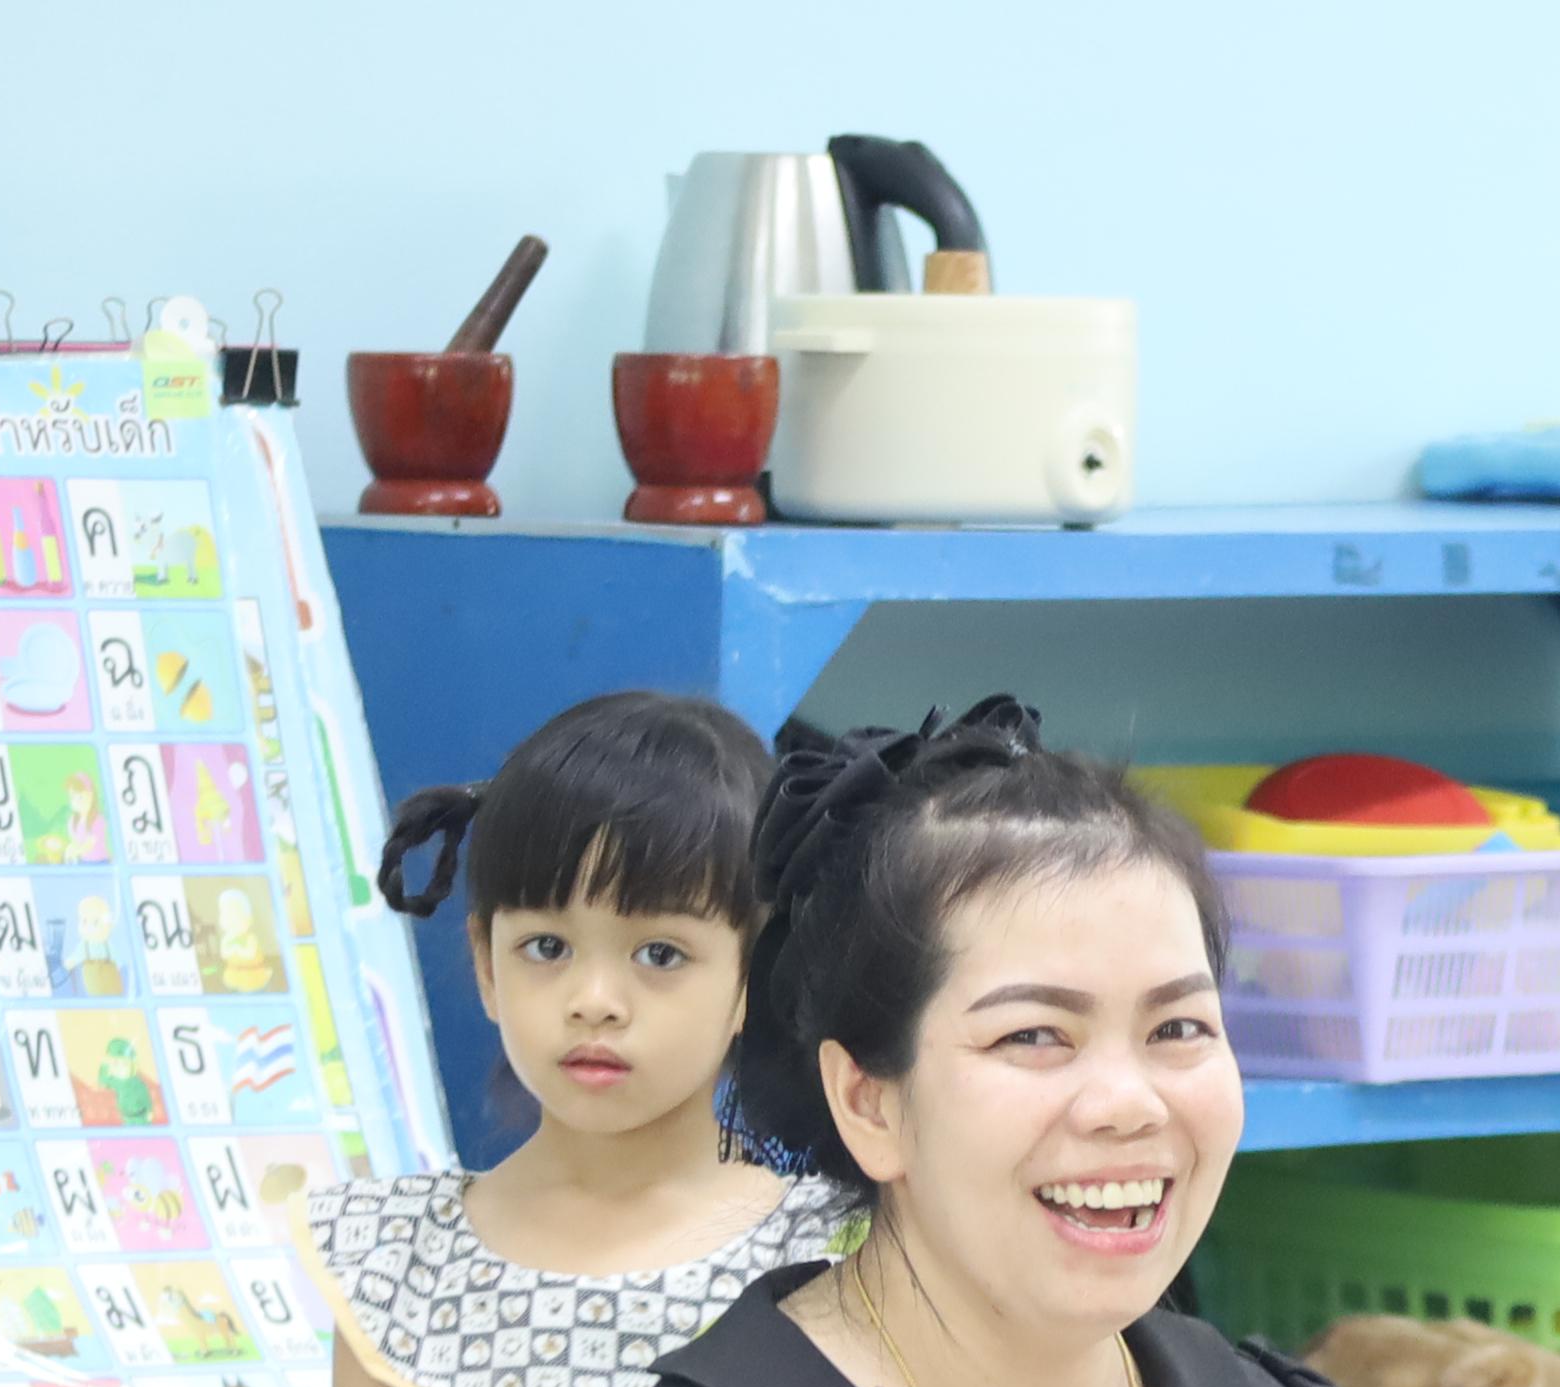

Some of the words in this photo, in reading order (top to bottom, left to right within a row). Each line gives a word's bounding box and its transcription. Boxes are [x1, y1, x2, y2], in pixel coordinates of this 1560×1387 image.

[82, 506, 119, 558] ค
[98, 635, 145, 691] ฉ
[121, 752, 165, 835] ฎ
[136, 898, 194, 951] ณ
[12, 1026, 61, 1081] ท
[171, 1022, 208, 1078] ธ
[205, 1143, 251, 1212] ฝ
[94, 1284, 147, 1332] ม
[249, 1279, 294, 1327] ย
